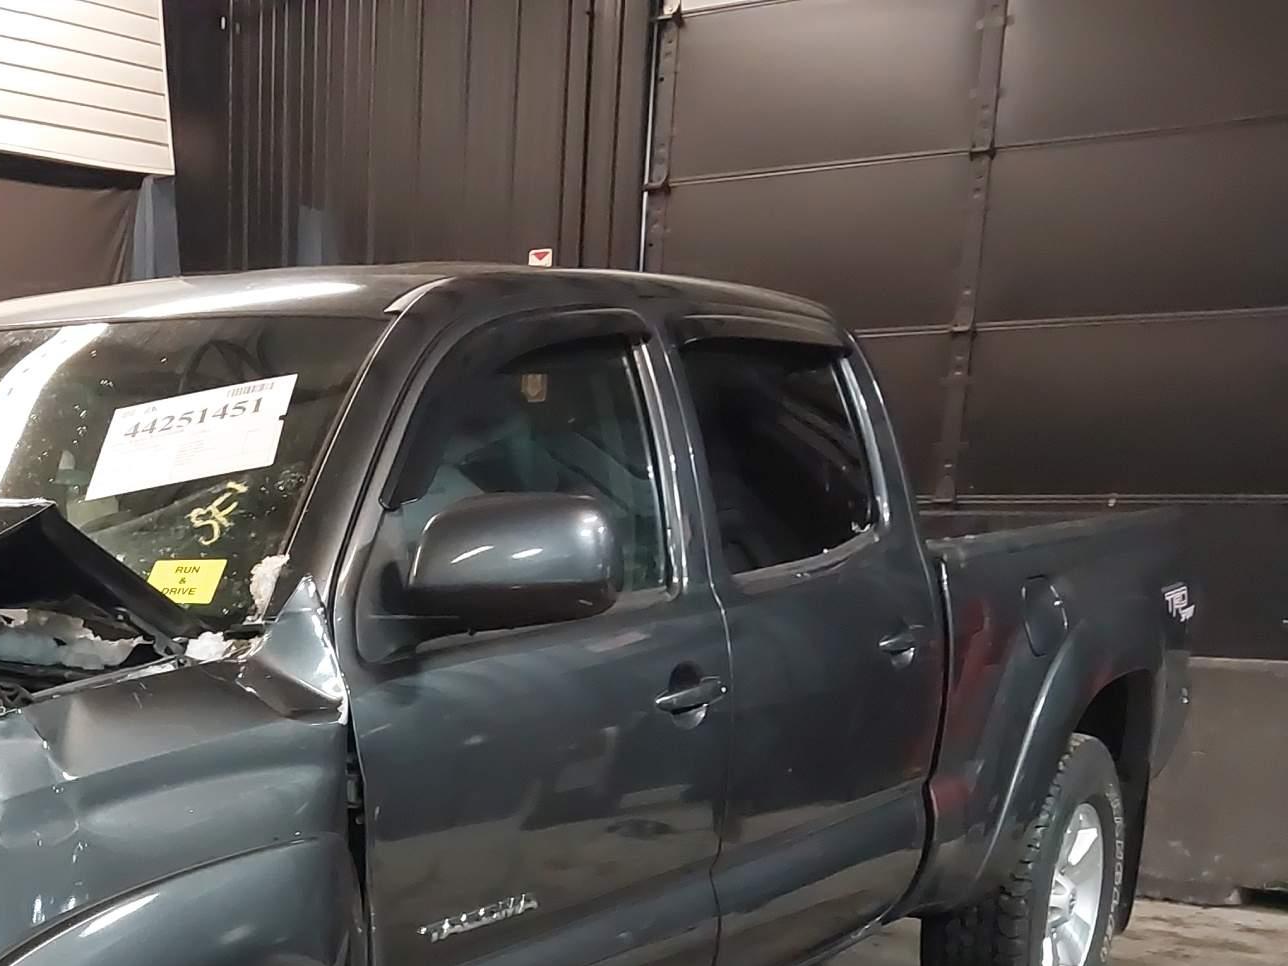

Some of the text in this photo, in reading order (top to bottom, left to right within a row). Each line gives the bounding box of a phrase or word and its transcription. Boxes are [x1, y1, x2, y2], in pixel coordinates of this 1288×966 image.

[124, 397, 264, 438] 44251451
[175, 565, 201, 574] RUN
[162, 587, 196, 596] DRIVE
